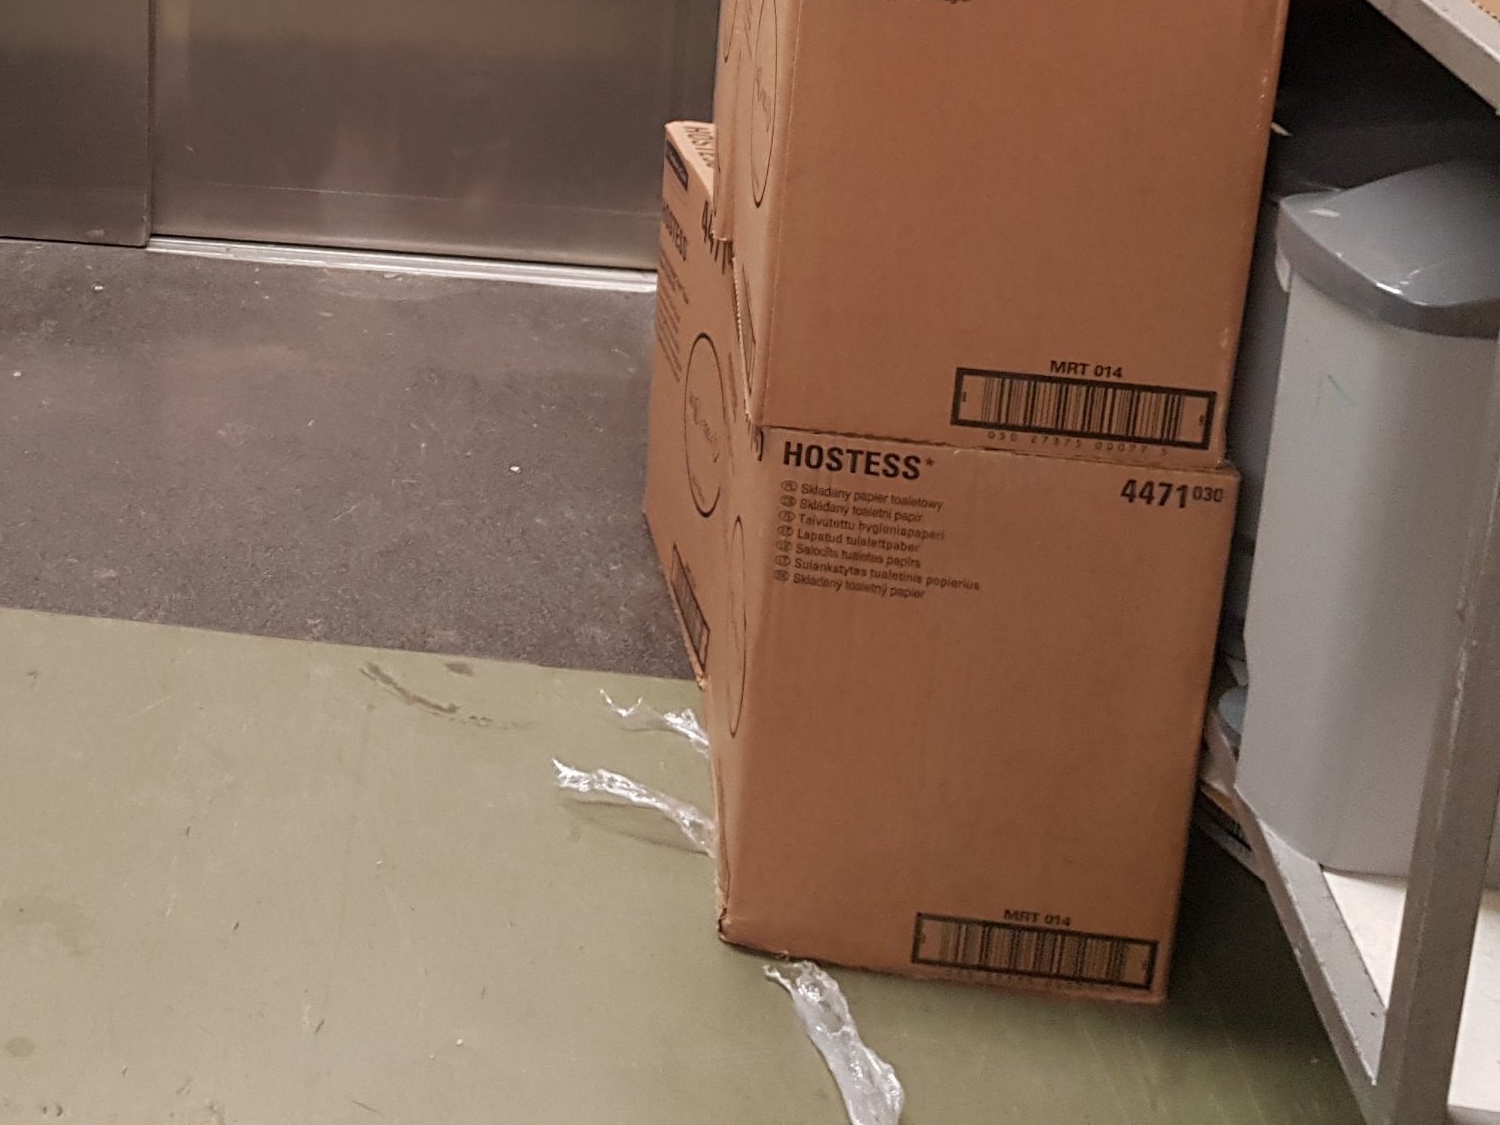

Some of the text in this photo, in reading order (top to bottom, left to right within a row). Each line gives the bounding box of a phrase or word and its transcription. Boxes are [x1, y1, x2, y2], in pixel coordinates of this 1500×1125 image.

[1050, 360, 1123, 378] MRT 014
[1121, 479, 1224, 508] 4471 030
[1003, 909, 1072, 926] MRT 014
